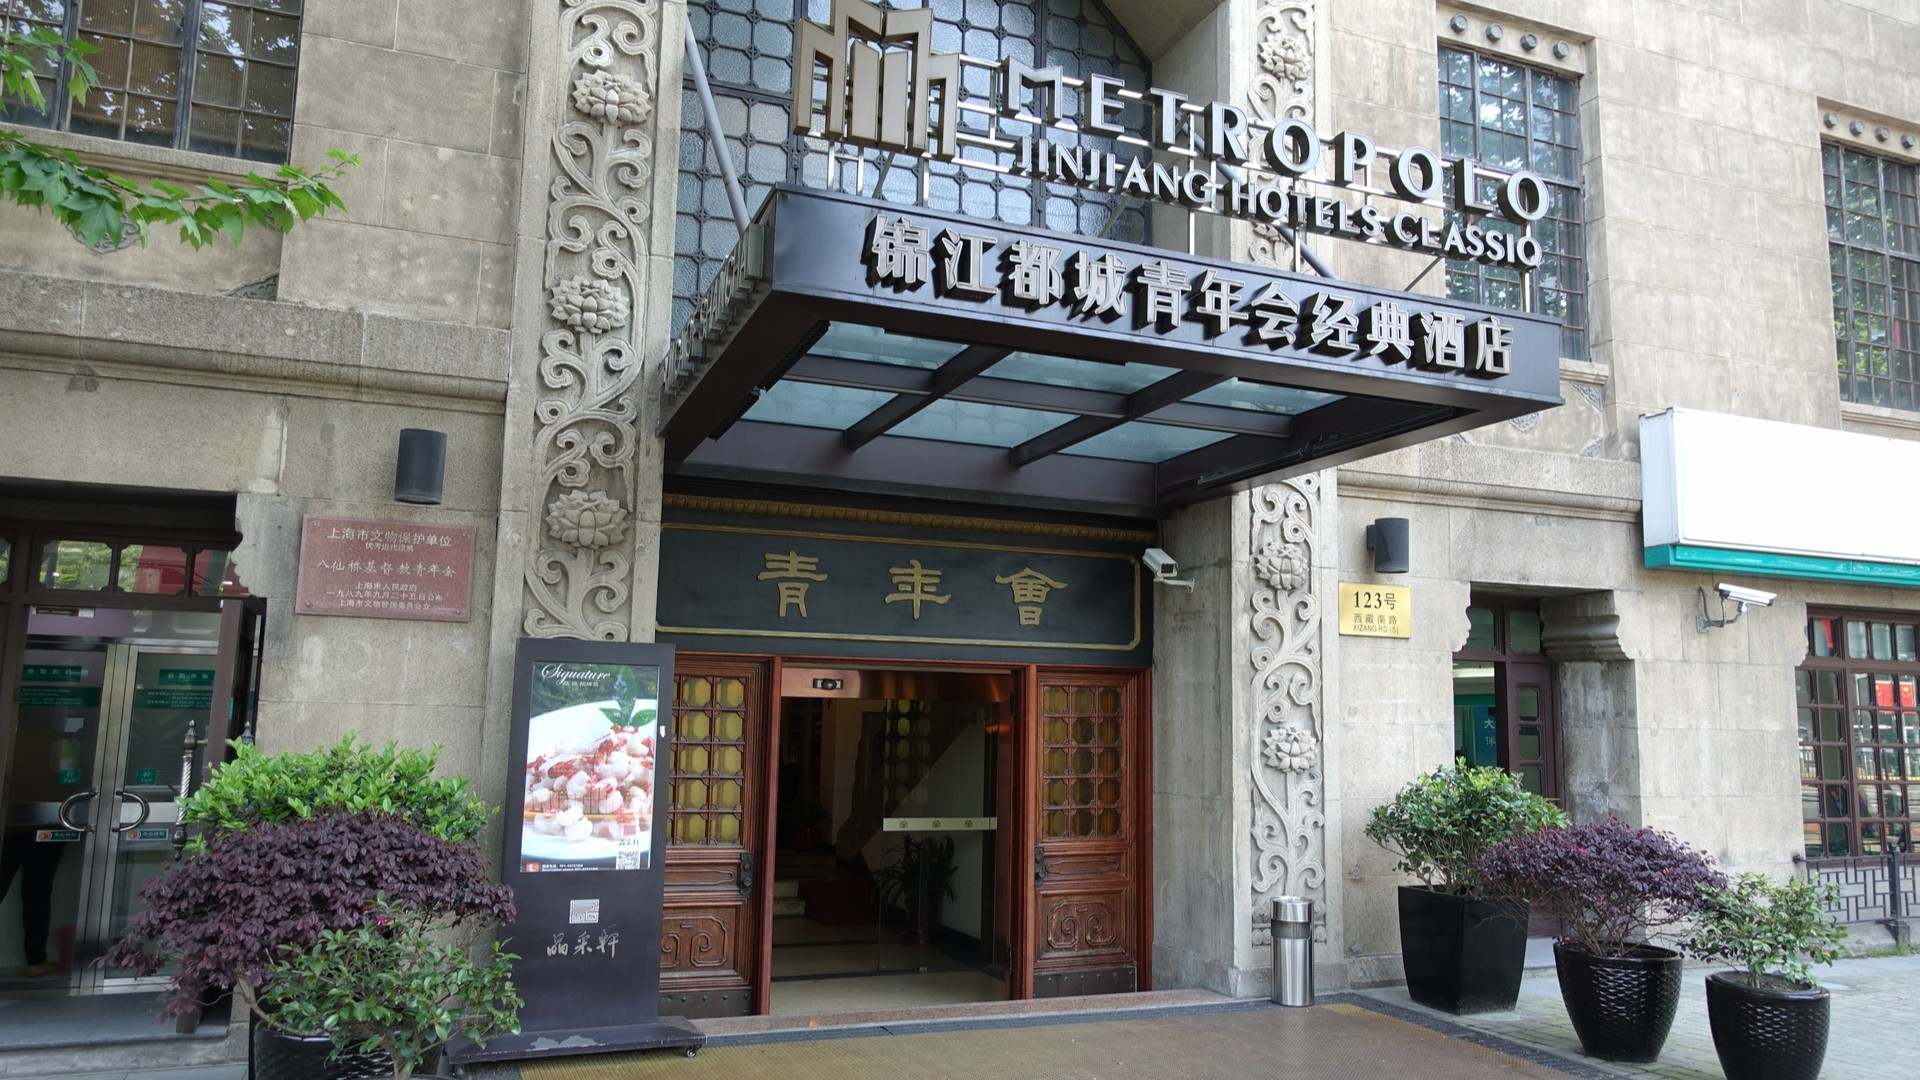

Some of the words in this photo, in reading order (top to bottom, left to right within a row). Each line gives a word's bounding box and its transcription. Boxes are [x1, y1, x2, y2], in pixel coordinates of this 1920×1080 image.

[1001, 54, 1550, 225] METROPOLO
[1014, 135, 1212, 208] JINJIANG
[1223, 179, 1382, 240] HOTELS
[866, 214, 1514, 378] 锦江都城青年会经典酒店
[326, 527, 452, 548] 上海市文物保护单位
[316, 559, 456, 578] 八仙桥基督教青年会
[326, 589, 443, 602] 一九八九年九月二十五日公布
[355, 581, 418, 592] 上海市人民政府
[757, 550, 1069, 627] 青年會
[338, 598, 431, 610] 上海市文物管理委员会立
[1353, 590, 1397, 611] 123号
[1352, 623, 1378, 633] XIZANG
[1353, 613, 1397, 626] 西藏南路
[541, 663, 611, 685] Signature
